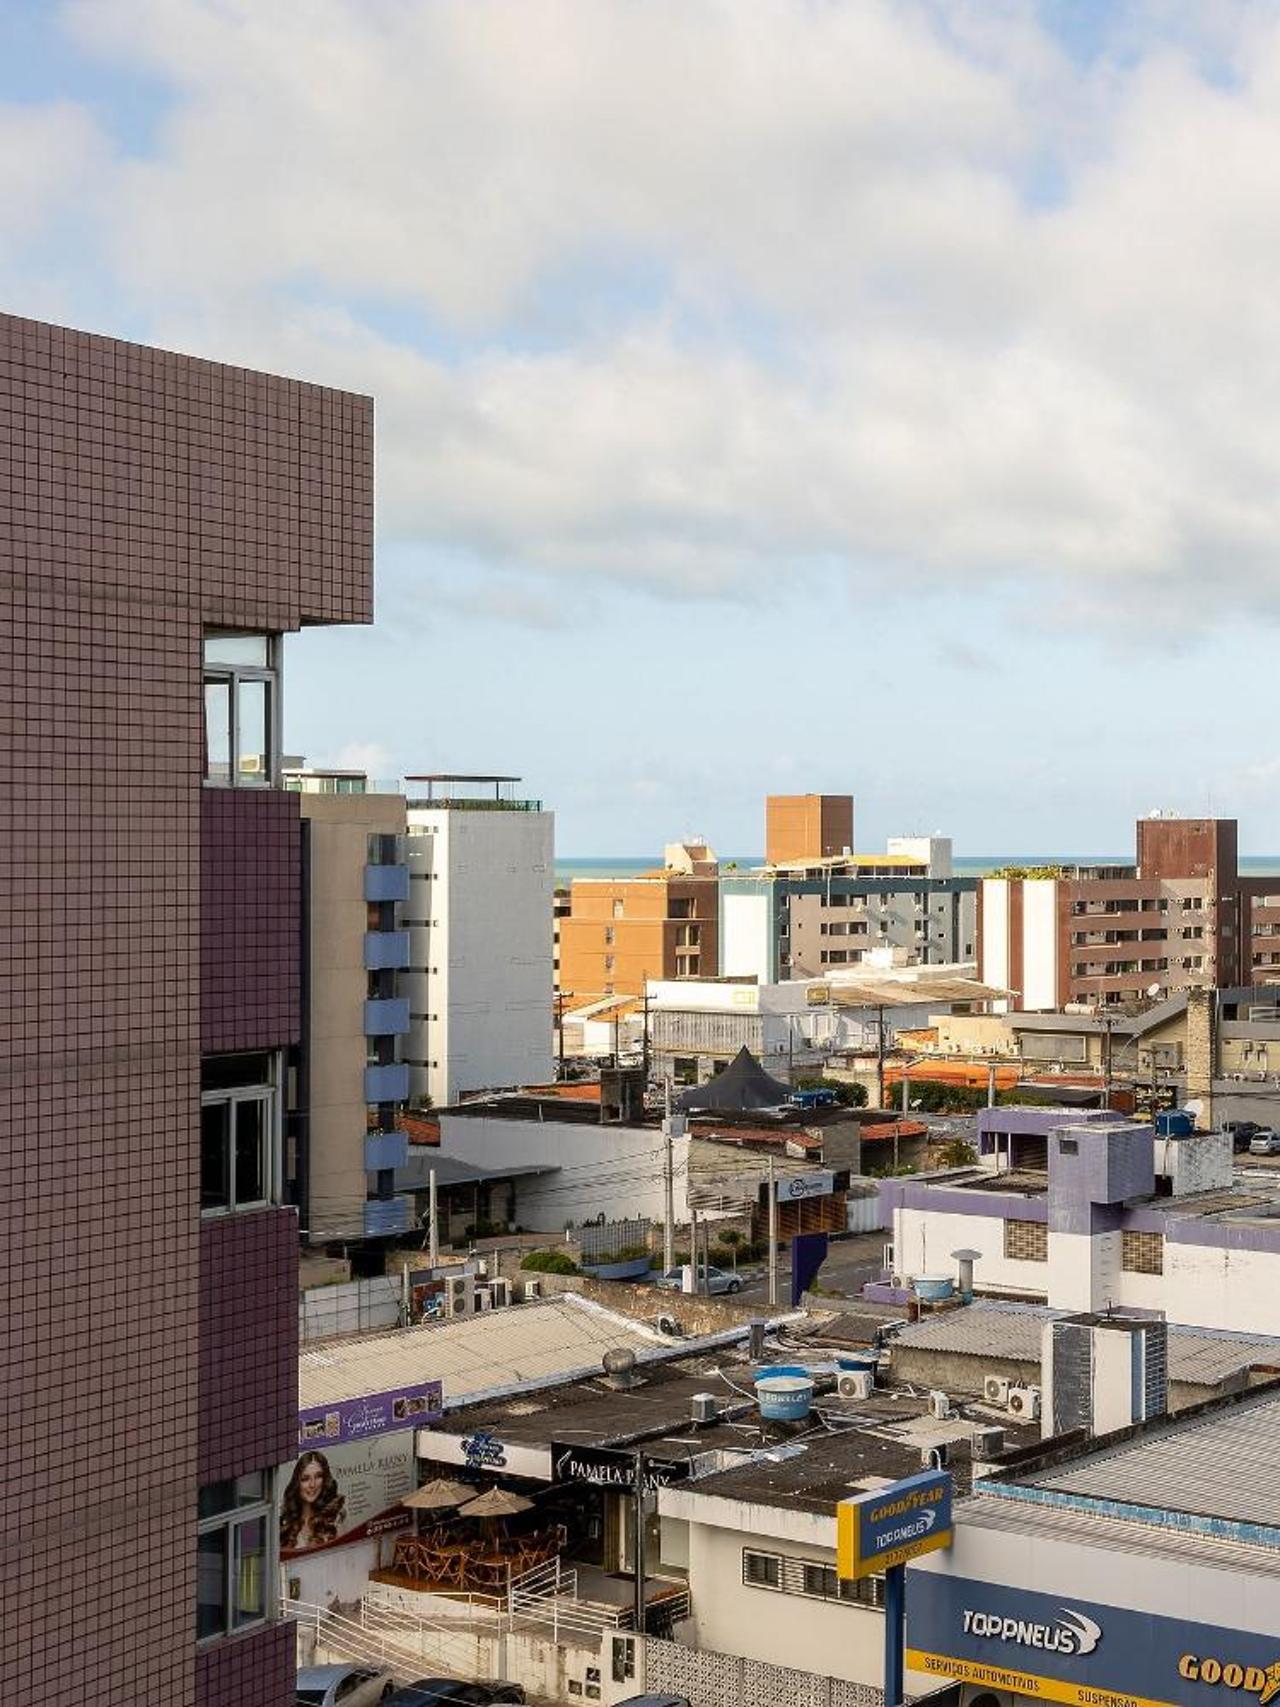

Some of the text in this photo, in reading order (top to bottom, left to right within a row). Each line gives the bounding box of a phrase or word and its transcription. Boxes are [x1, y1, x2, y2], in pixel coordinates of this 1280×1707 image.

[570, 1460, 623, 1485] PAMELA
[962, 1609, 1076, 1655] TOPPNEUS
[924, 1656, 1040, 1692] SERVIÇOS AUTOMOTIVOS
